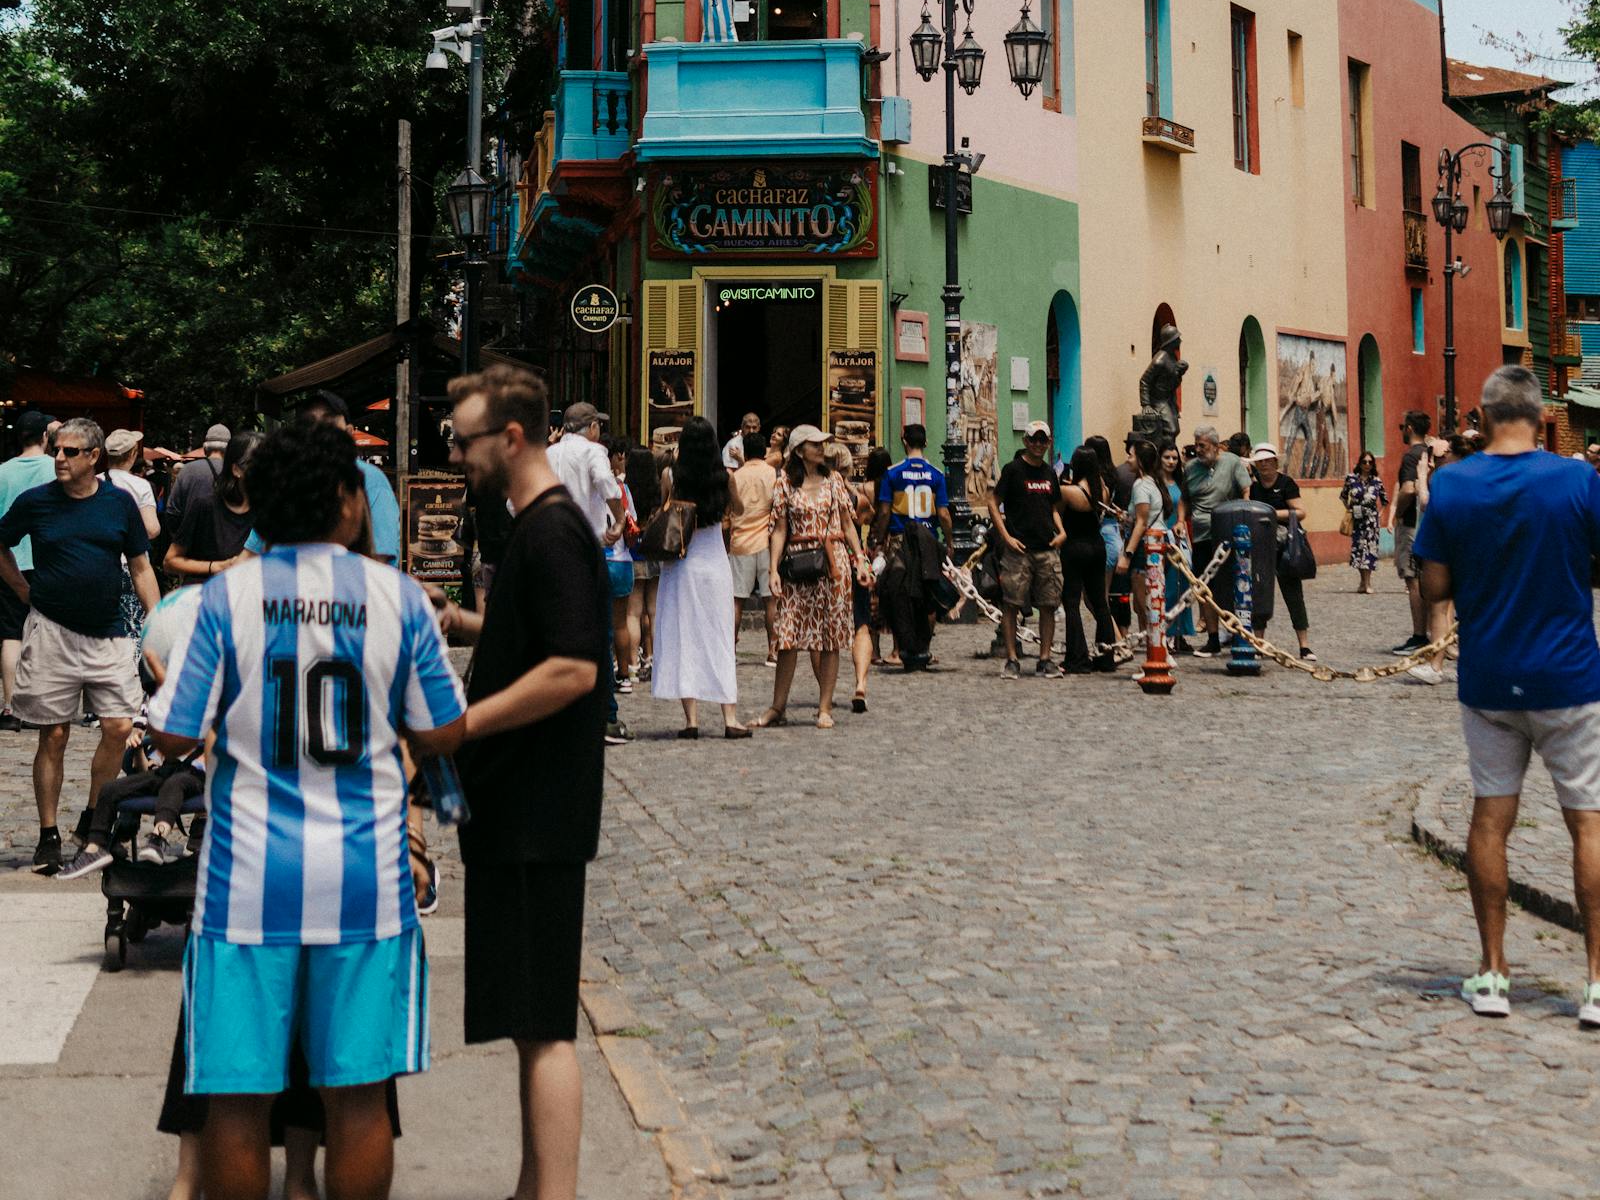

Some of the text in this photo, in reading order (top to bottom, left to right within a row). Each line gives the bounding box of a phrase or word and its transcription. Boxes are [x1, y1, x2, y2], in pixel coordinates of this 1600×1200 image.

[689, 204, 836, 238] CAMINITO
[723, 239, 799, 247] BUENOS AIRES
[720, 287, 815, 302] @VISITCAMINITO
[582, 314, 607, 322] CAMINITO
[652, 357, 693, 366] ALFAJOR
[832, 357, 874, 366] ALFAJOR
[904, 484, 932, 519] 10
[422, 560, 454, 568] CAMINITO
[263, 599, 367, 628] MARADONA
[267, 654, 366, 770] 10
